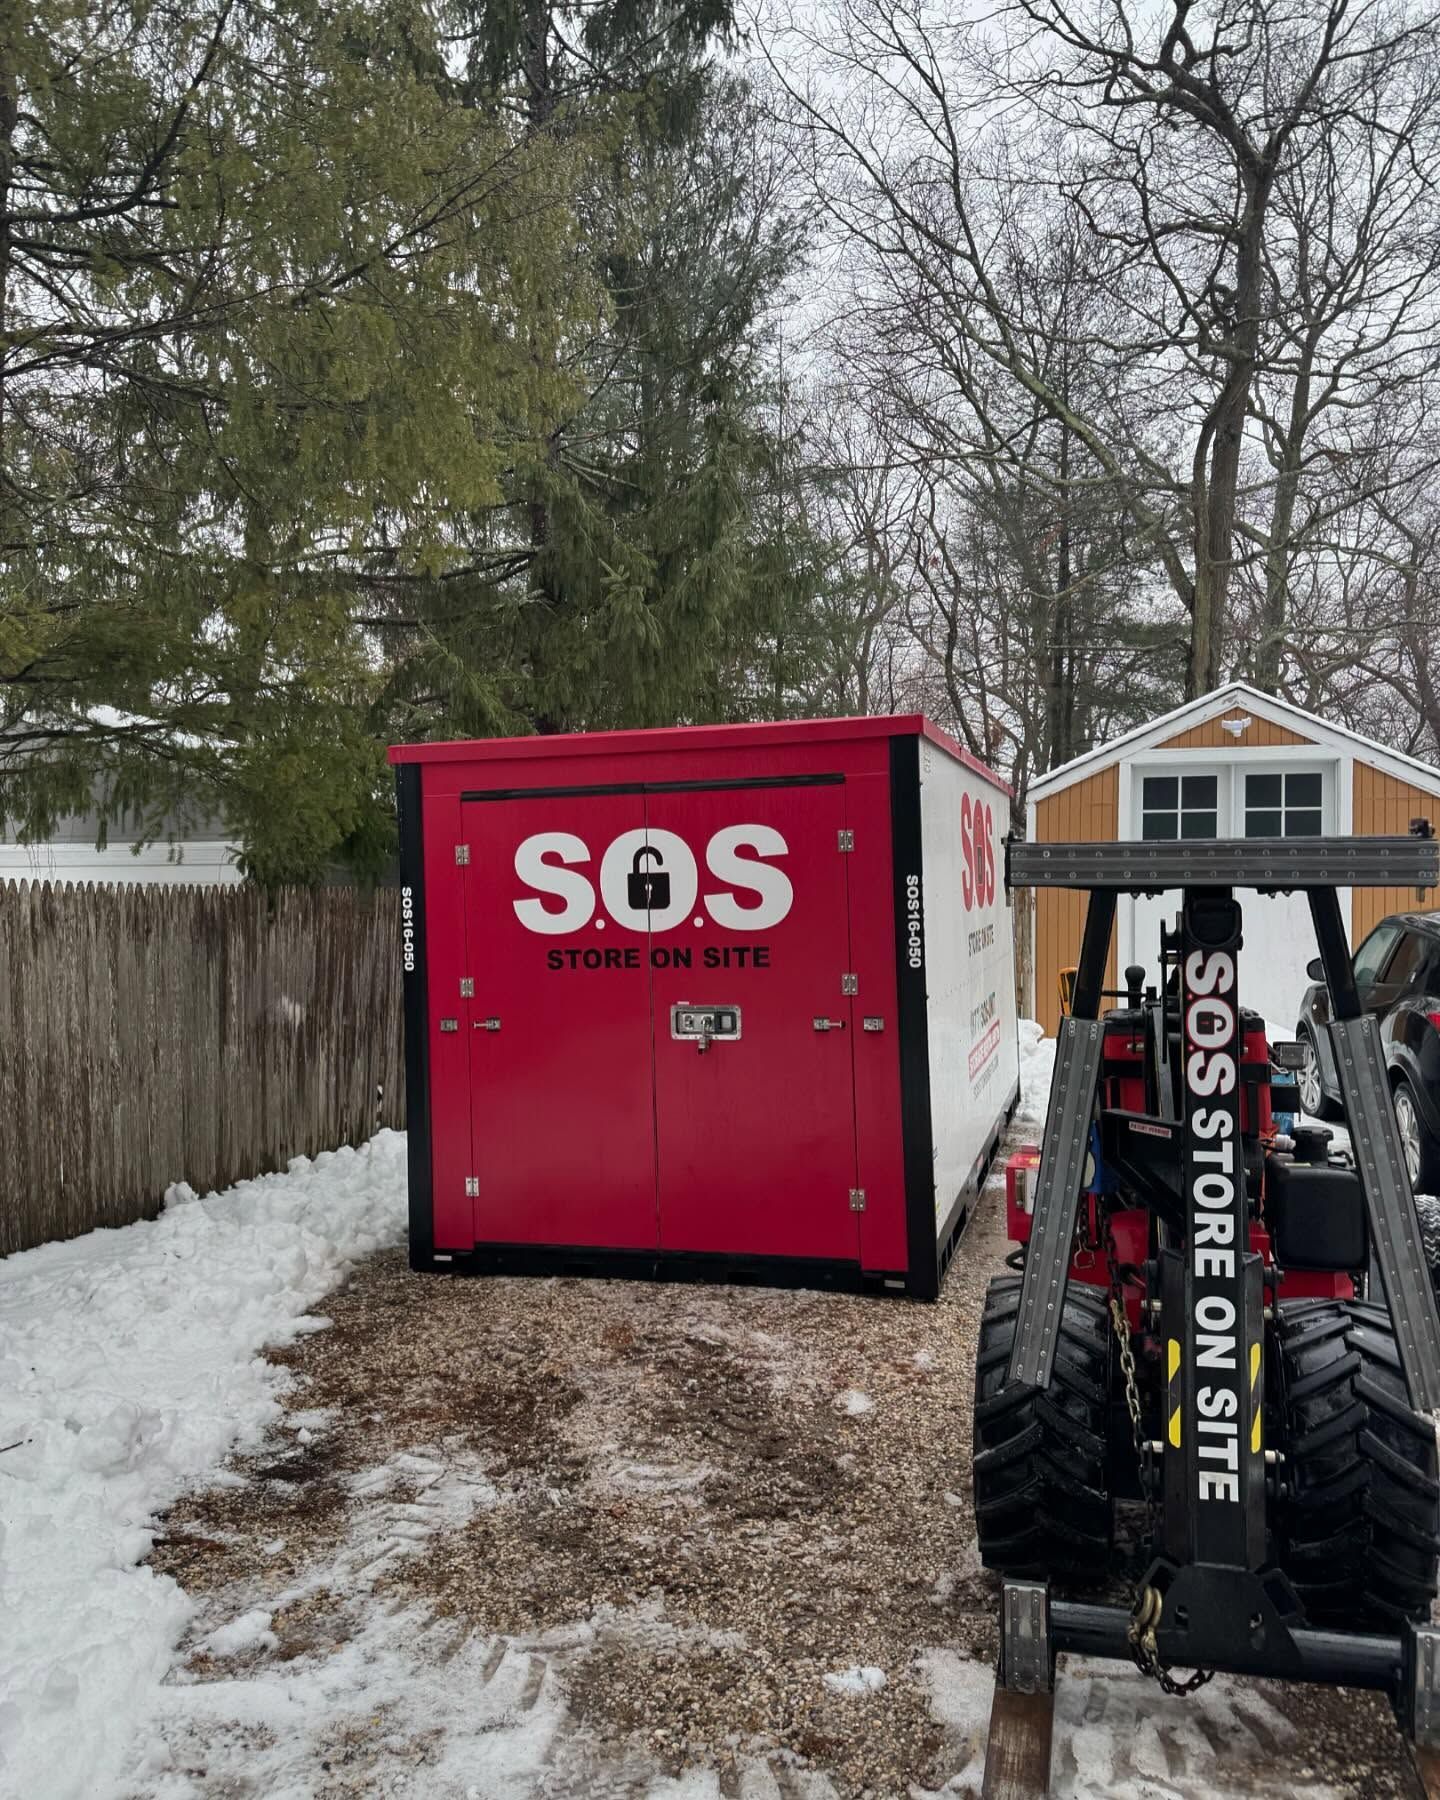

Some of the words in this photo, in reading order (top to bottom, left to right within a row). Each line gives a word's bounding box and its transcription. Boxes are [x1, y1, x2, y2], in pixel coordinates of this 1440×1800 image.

[401, 886, 415, 971] SOS16-050
[546, 948, 641, 970] STORE
[649, 947, 692, 969] ON
[702, 946, 771, 968] SITE
[906, 874, 922, 968] SOS16-050
[1191, 1107, 1235, 1278] STORE
[1194, 1295, 1237, 1370] ON
[1196, 1385, 1240, 1503] SITE
